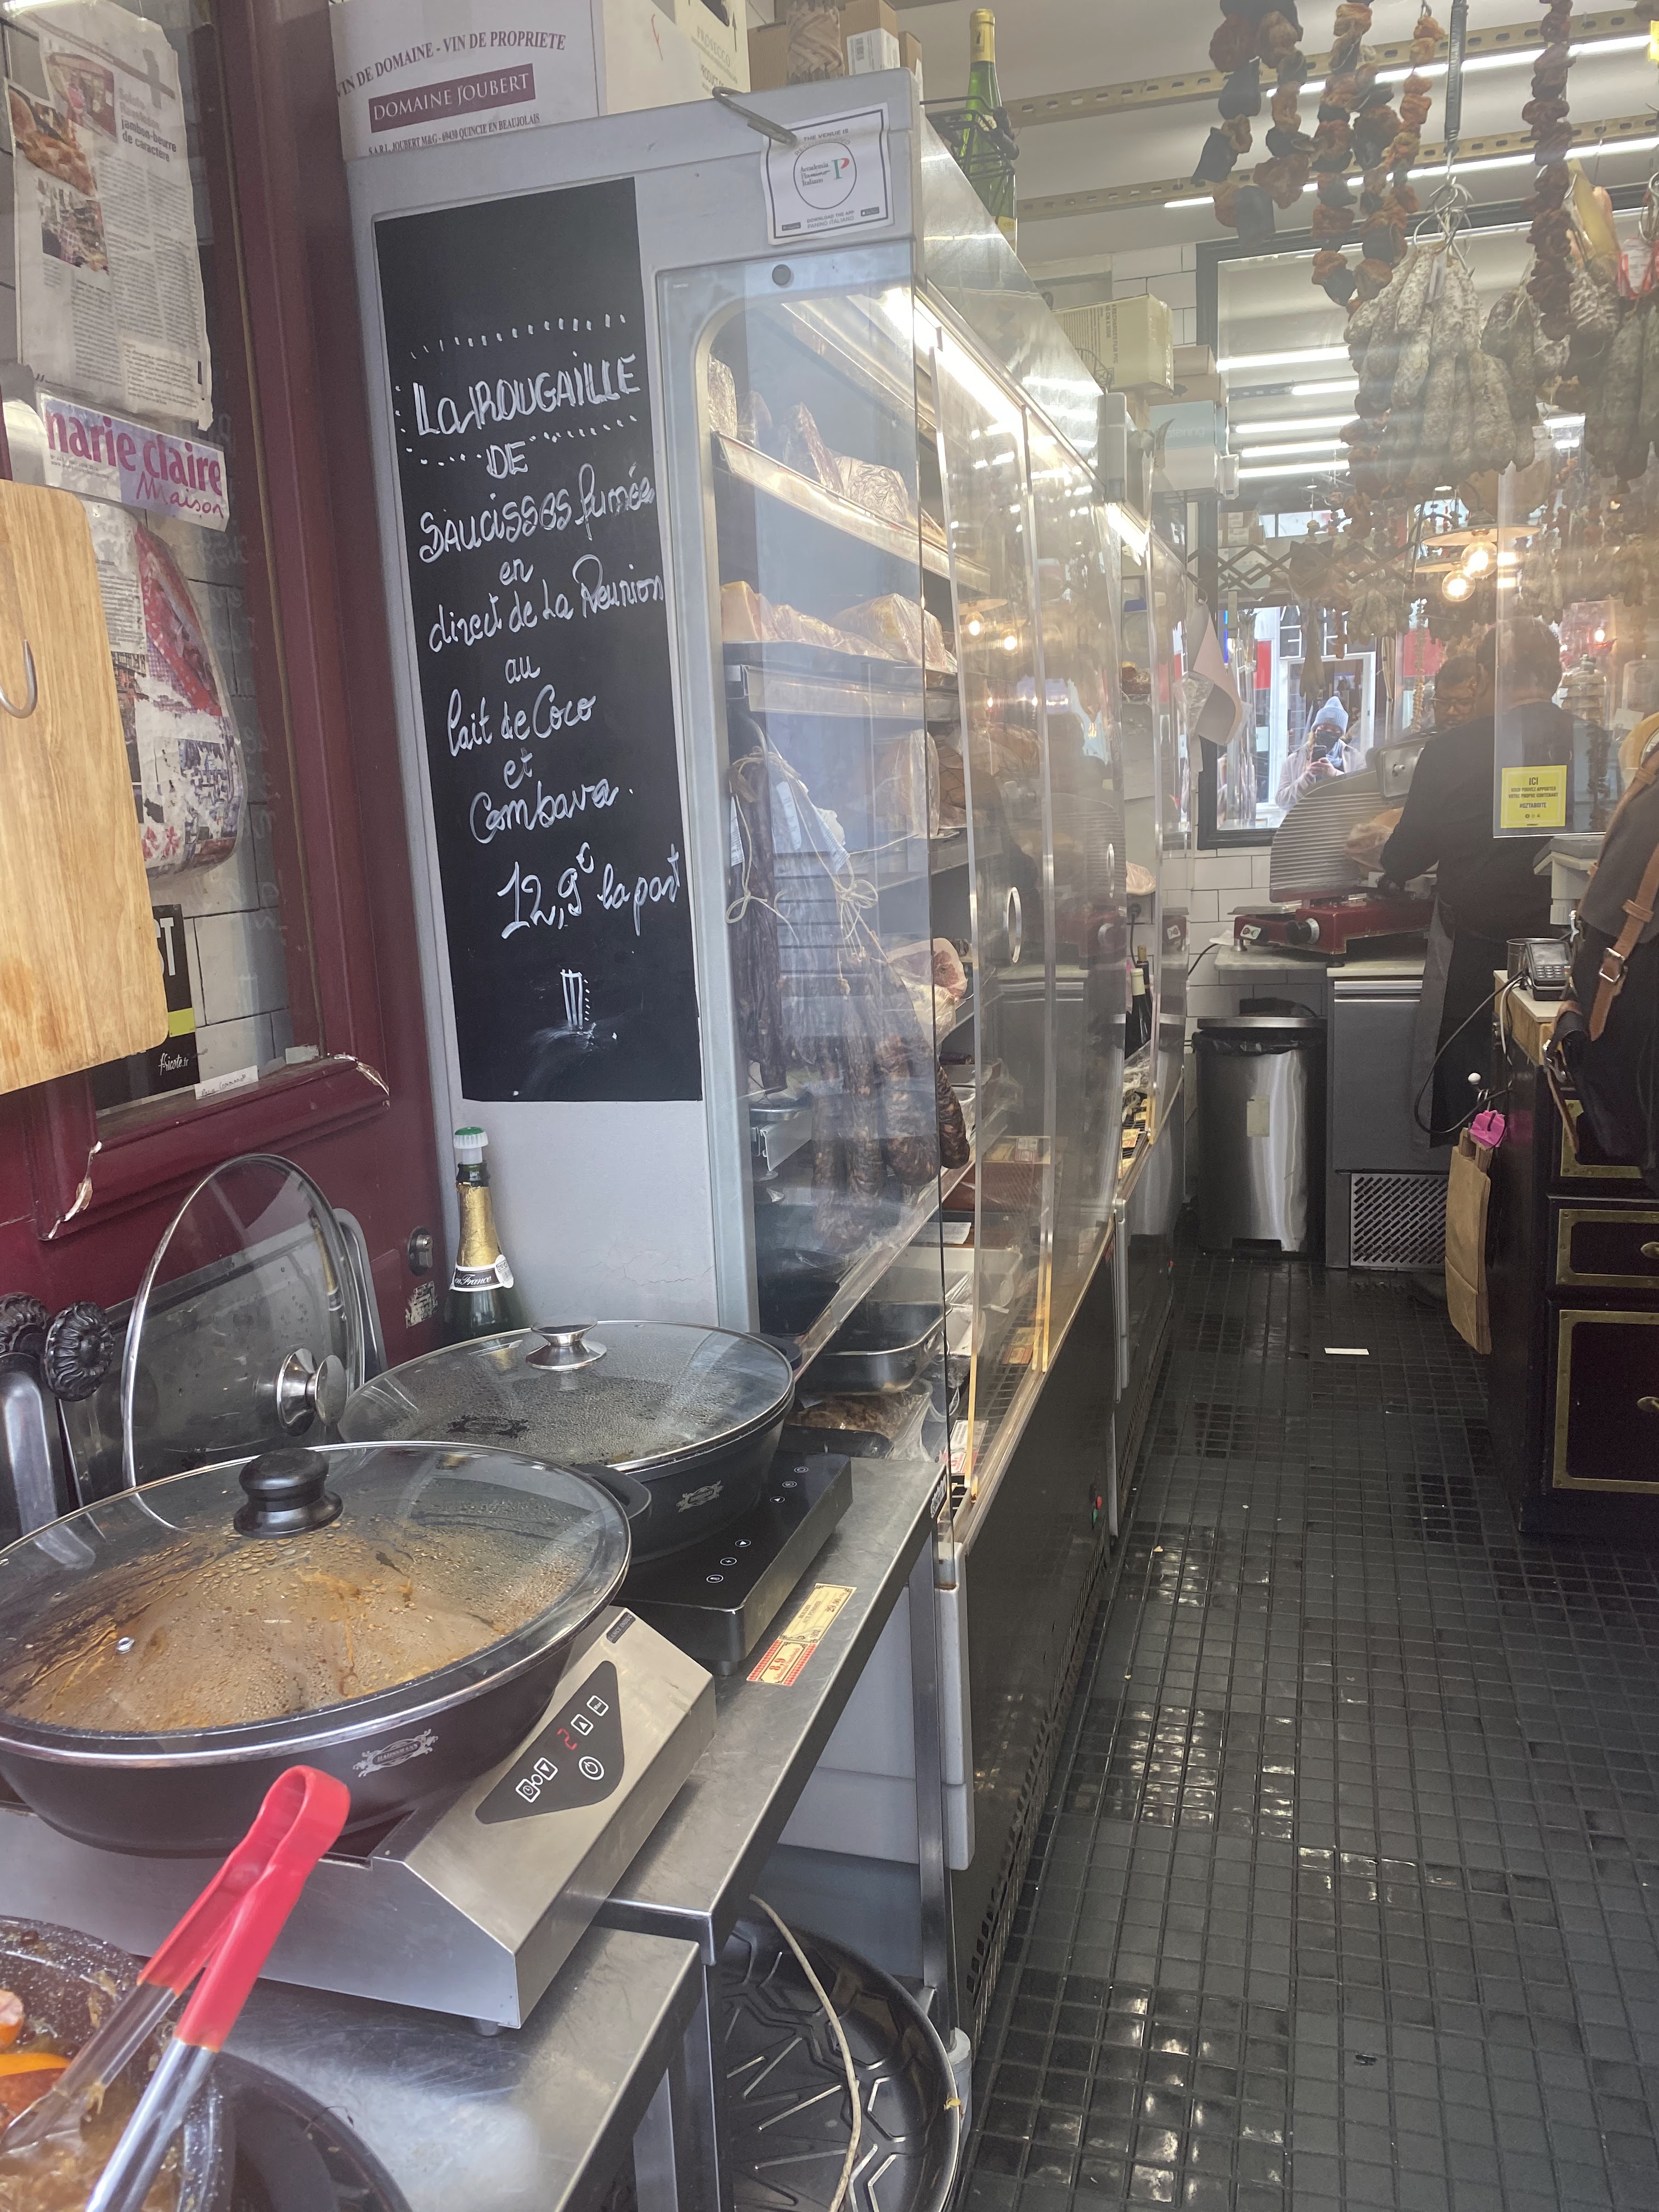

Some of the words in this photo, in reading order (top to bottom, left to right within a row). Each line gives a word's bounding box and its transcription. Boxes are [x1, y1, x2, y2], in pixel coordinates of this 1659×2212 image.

[356, 66, 374, 87] DE
[375, 42, 433, 77] DOMAINE
[443, 35, 466, 52] VIN
[470, 32, 487, 49] DE
[490, 31, 566, 50] PROPRIETE
[374, 89, 452, 120] DOMAINE
[457, 73, 529, 105] JOUBERT
[392, 137, 420, 151] JOUBERT
[489, 122, 498, 132] EN
[499, 113, 540, 130] BEAUJOLAIS
[818, 130, 841, 138] VENUE
[143, 435, 223, 496] claire
[486, 441, 529, 479] DE
[499, 558, 534, 585] en
[429, 593, 502, 652] direct
[509, 591, 538, 633] de
[505, 656, 540, 684] au
[447, 689, 492, 757] lait
[501, 701, 530, 740] de
[532, 684, 596, 738] Coco
[504, 747, 533, 789] et
[1529, 777, 1538, 785] ICI
[633, 844, 680, 936] part
[460, 1274, 492, 1285] France
[769, 1658, 786, 1671] 8,9
[593, 1702, 602, 1710] Max
[557, 1728, 578, 1750] 2
